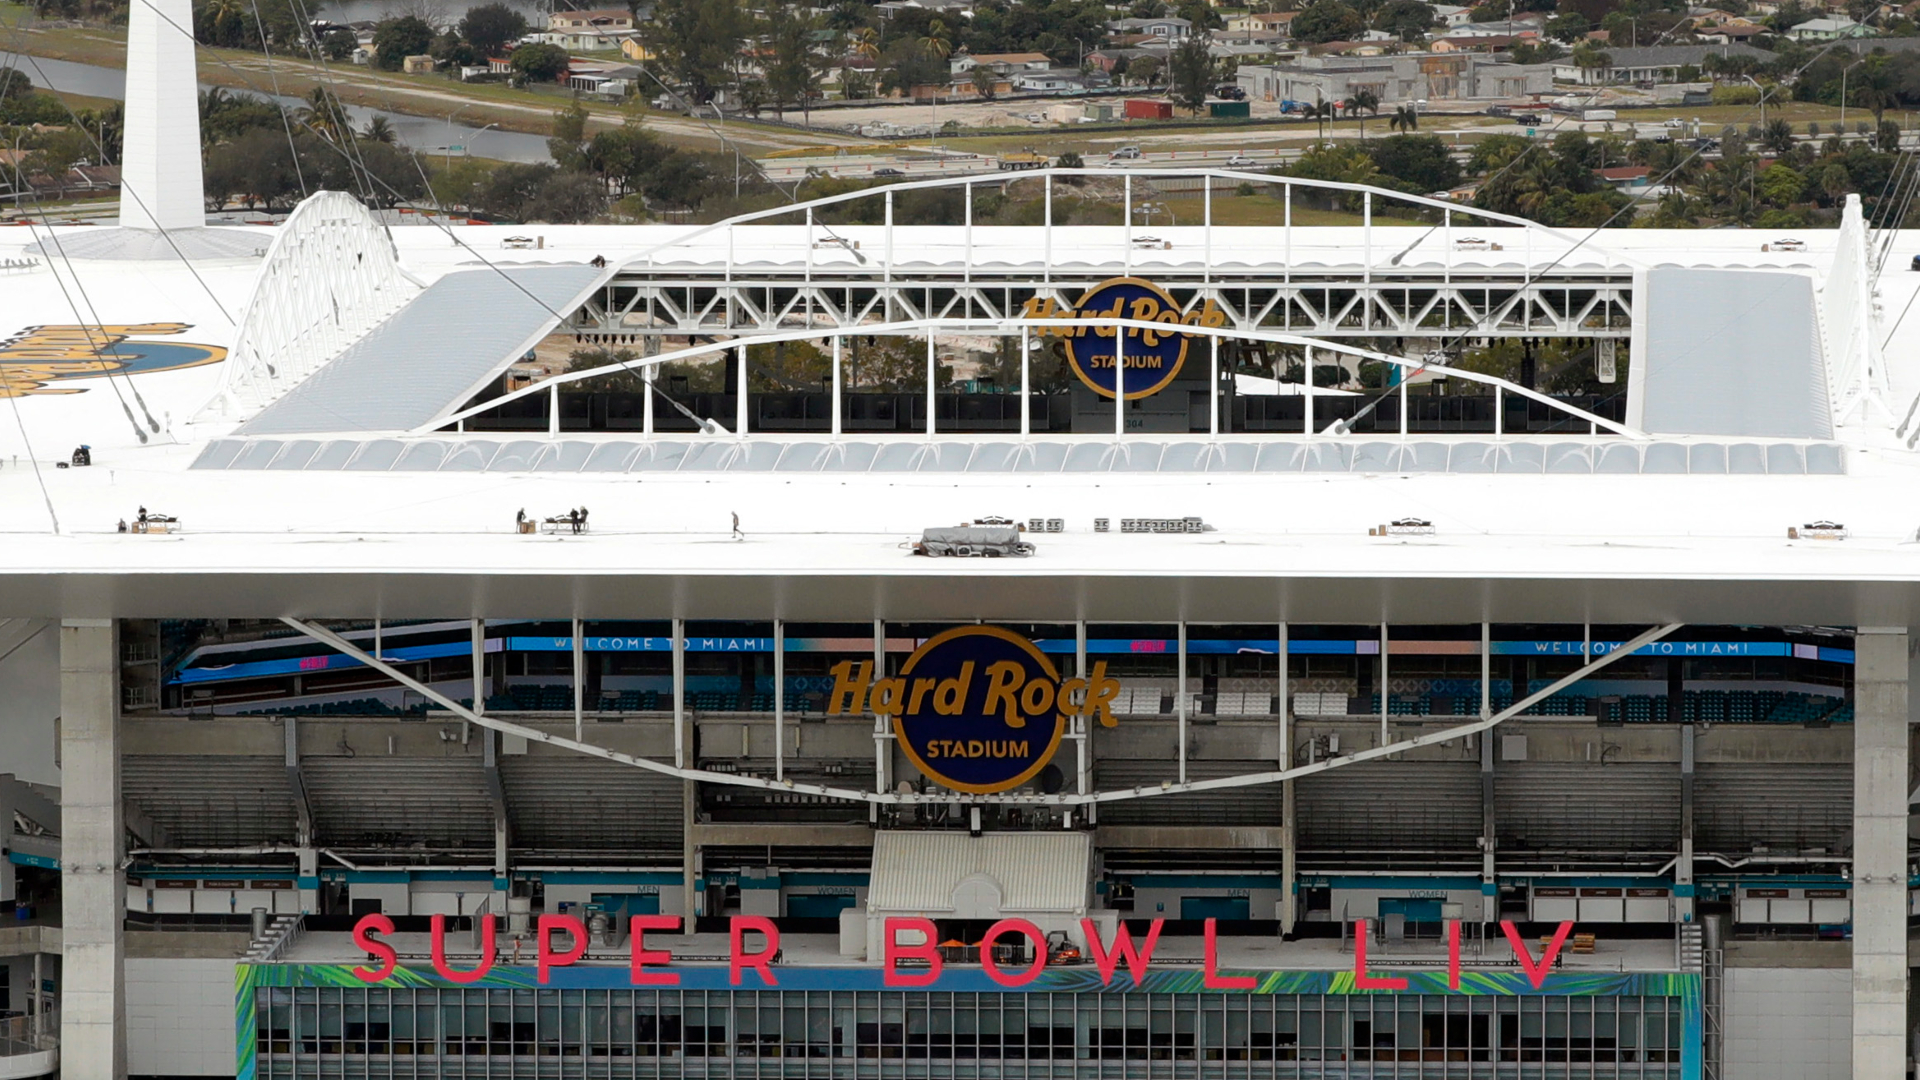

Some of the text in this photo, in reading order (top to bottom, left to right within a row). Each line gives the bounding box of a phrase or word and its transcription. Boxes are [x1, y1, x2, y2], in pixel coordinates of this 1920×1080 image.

[1023, 297, 1225, 347] Hard Rock
[1090, 355, 1162, 369] STADIUM
[1126, 419, 1143, 428] 304
[553, 637, 764, 650] WLCOME TO MIAMI
[1535, 641, 1748, 654] WELCOM TO MIAMI
[828, 660, 1121, 728] Hard Rock
[927, 740, 1029, 758] STADIUM
[637, 885, 660, 894] MEN
[817, 886, 857, 895] WOMEN
[1227, 889, 1250, 897] MEN
[1409, 890, 1448, 898] WOMEN
[353, 914, 1573, 989] SUPER BOWL LIV
